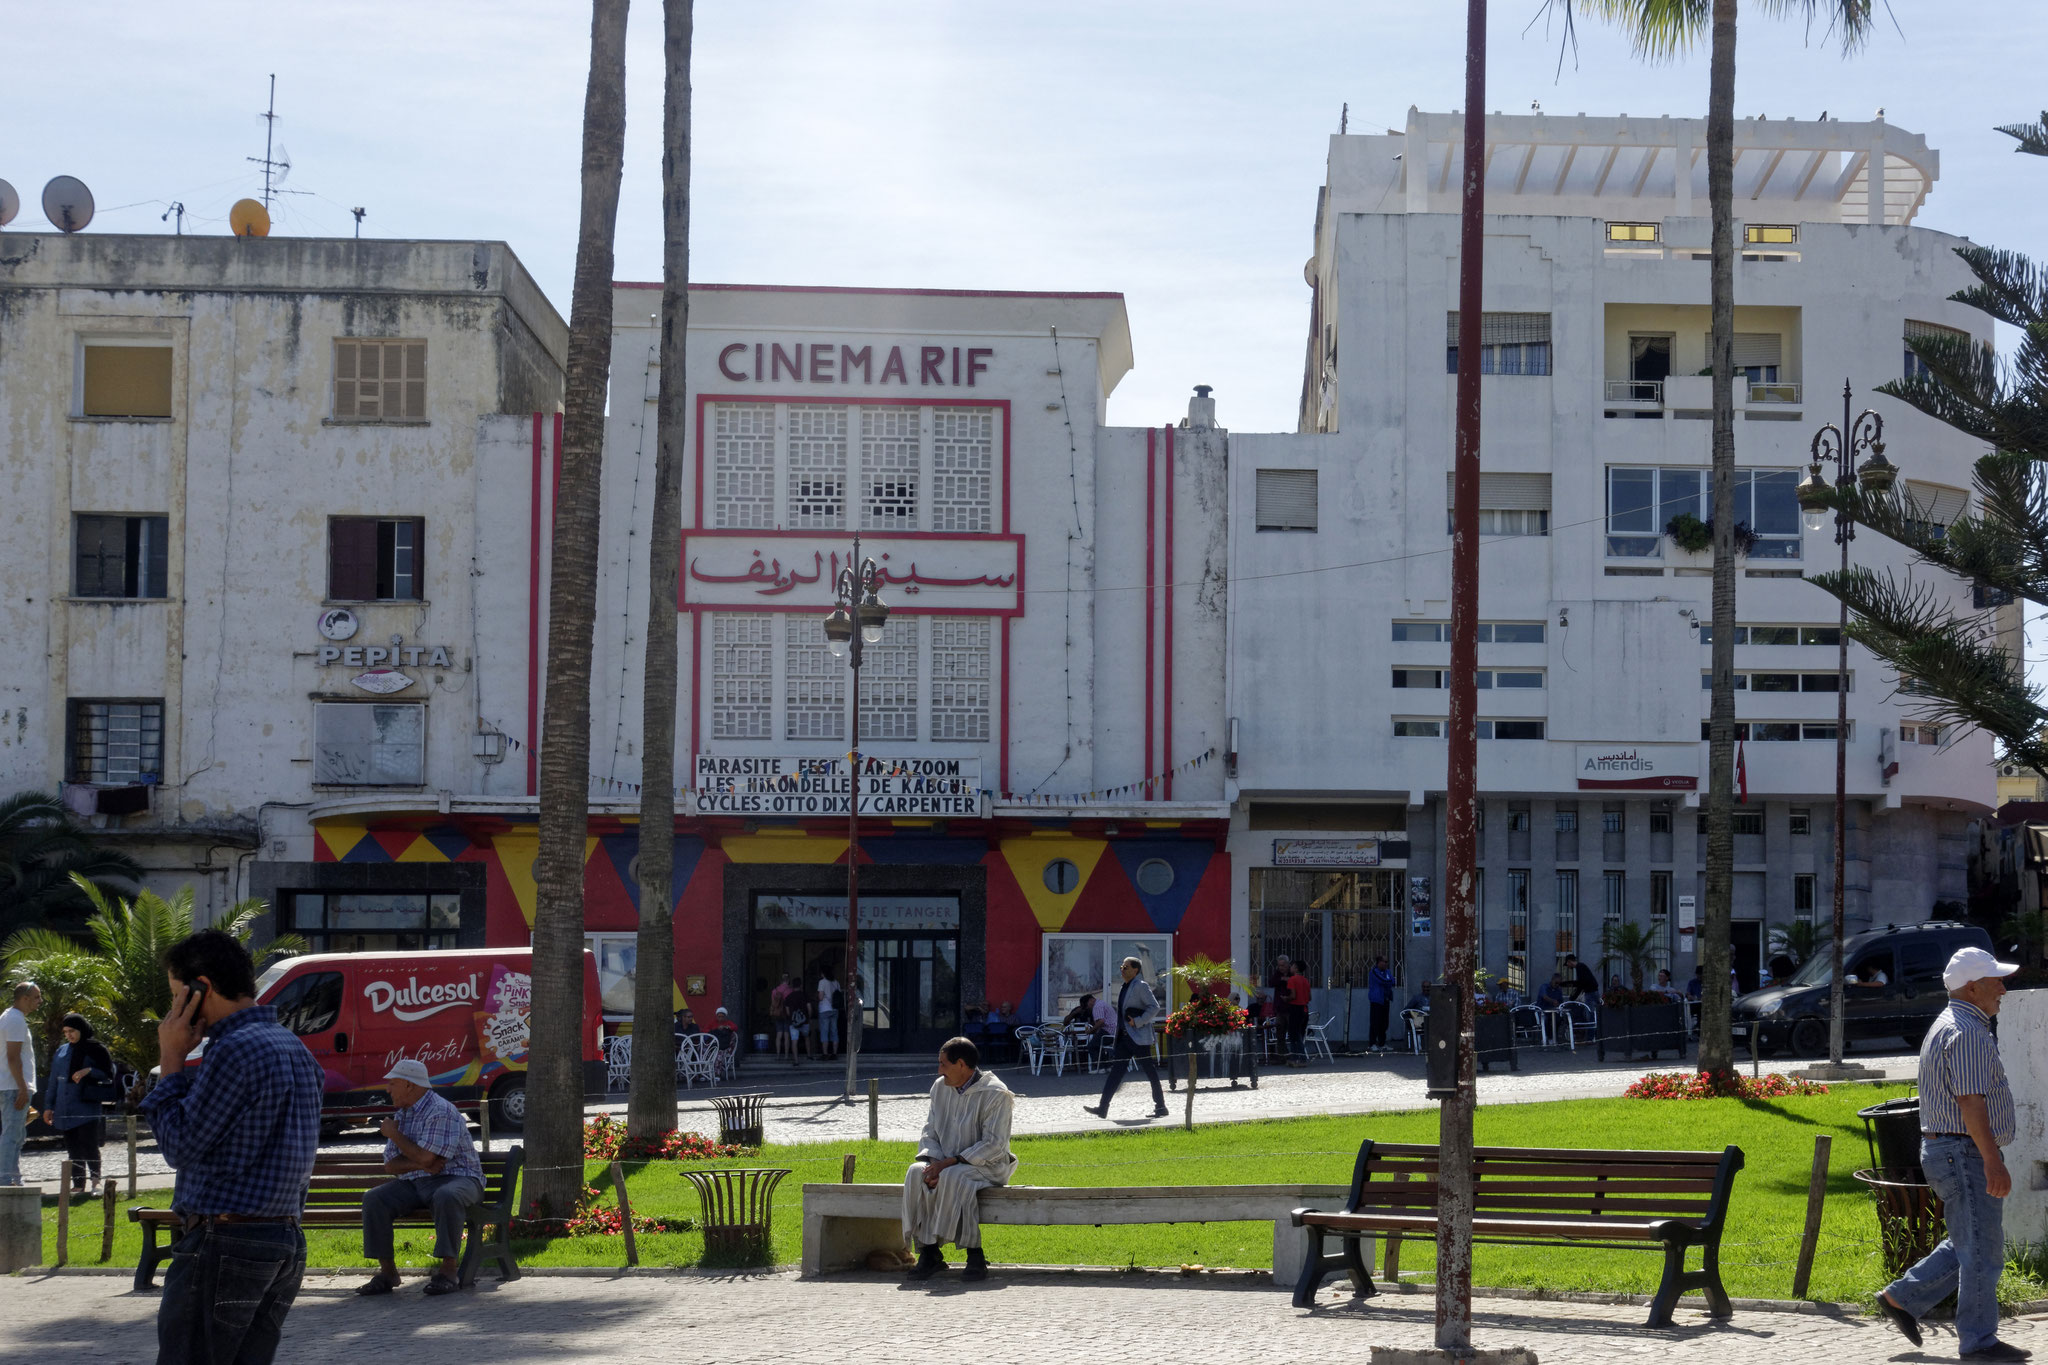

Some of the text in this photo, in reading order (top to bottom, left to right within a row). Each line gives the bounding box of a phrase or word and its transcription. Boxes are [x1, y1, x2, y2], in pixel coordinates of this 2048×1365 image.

[718, 342, 993, 387] CINEMA RIF
[690, 549, 840, 596] الريف
[319, 634, 450, 667] PEPITA
[1597, 749, 1637, 761] أمانديس
[699, 758, 781, 775] PARASITE
[1584, 758, 1653, 771] Amendis
[706, 777, 971, 794] LES HIRONDELLE DE KABOUL
[823, 797, 850, 812] DIX
[874, 797, 975, 812] CARPENTER
[873, 906, 888, 917] DE
[896, 906, 952, 917] TANGER
[364, 974, 480, 1013] Dulcesol
[492, 1022, 524, 1040] Snack
